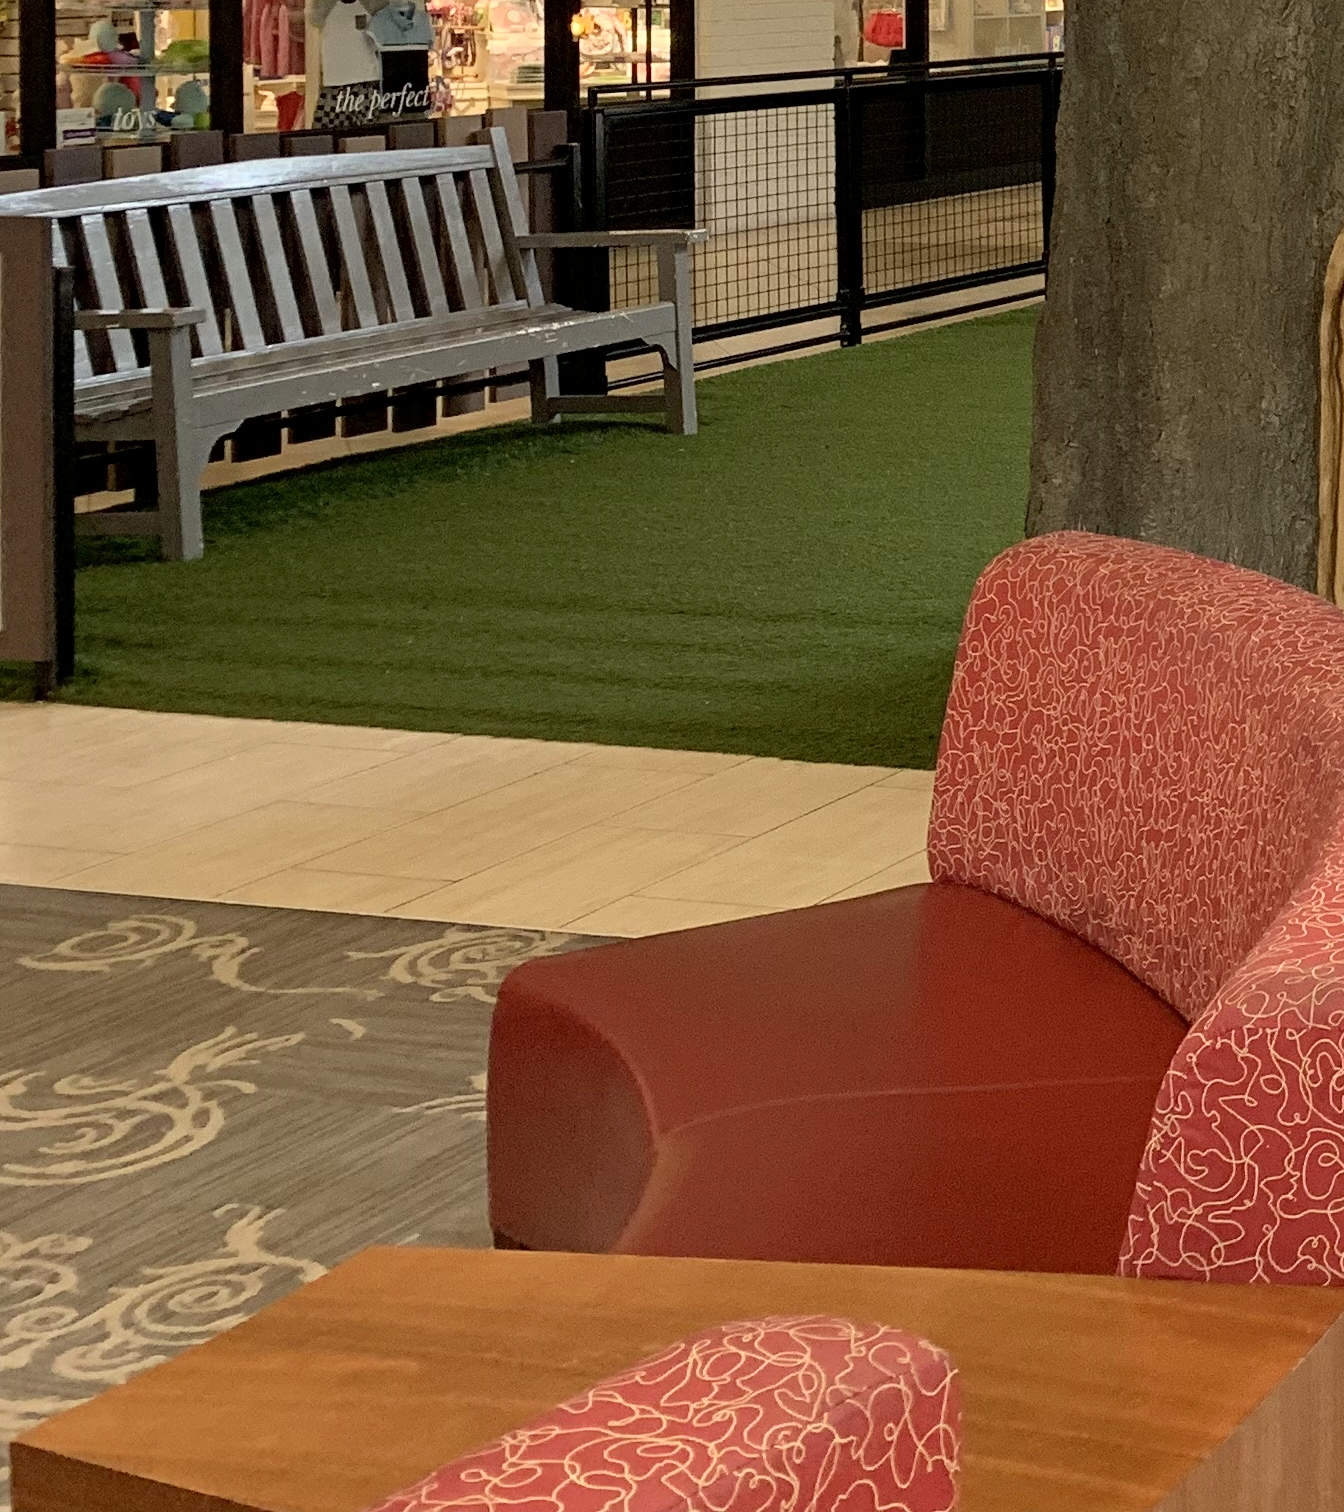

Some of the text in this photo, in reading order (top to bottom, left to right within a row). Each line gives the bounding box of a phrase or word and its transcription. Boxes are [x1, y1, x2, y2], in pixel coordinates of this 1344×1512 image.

[335, 87, 365, 113] the
[366, 82, 430, 119] perfect
[112, 107, 157, 139] toys
